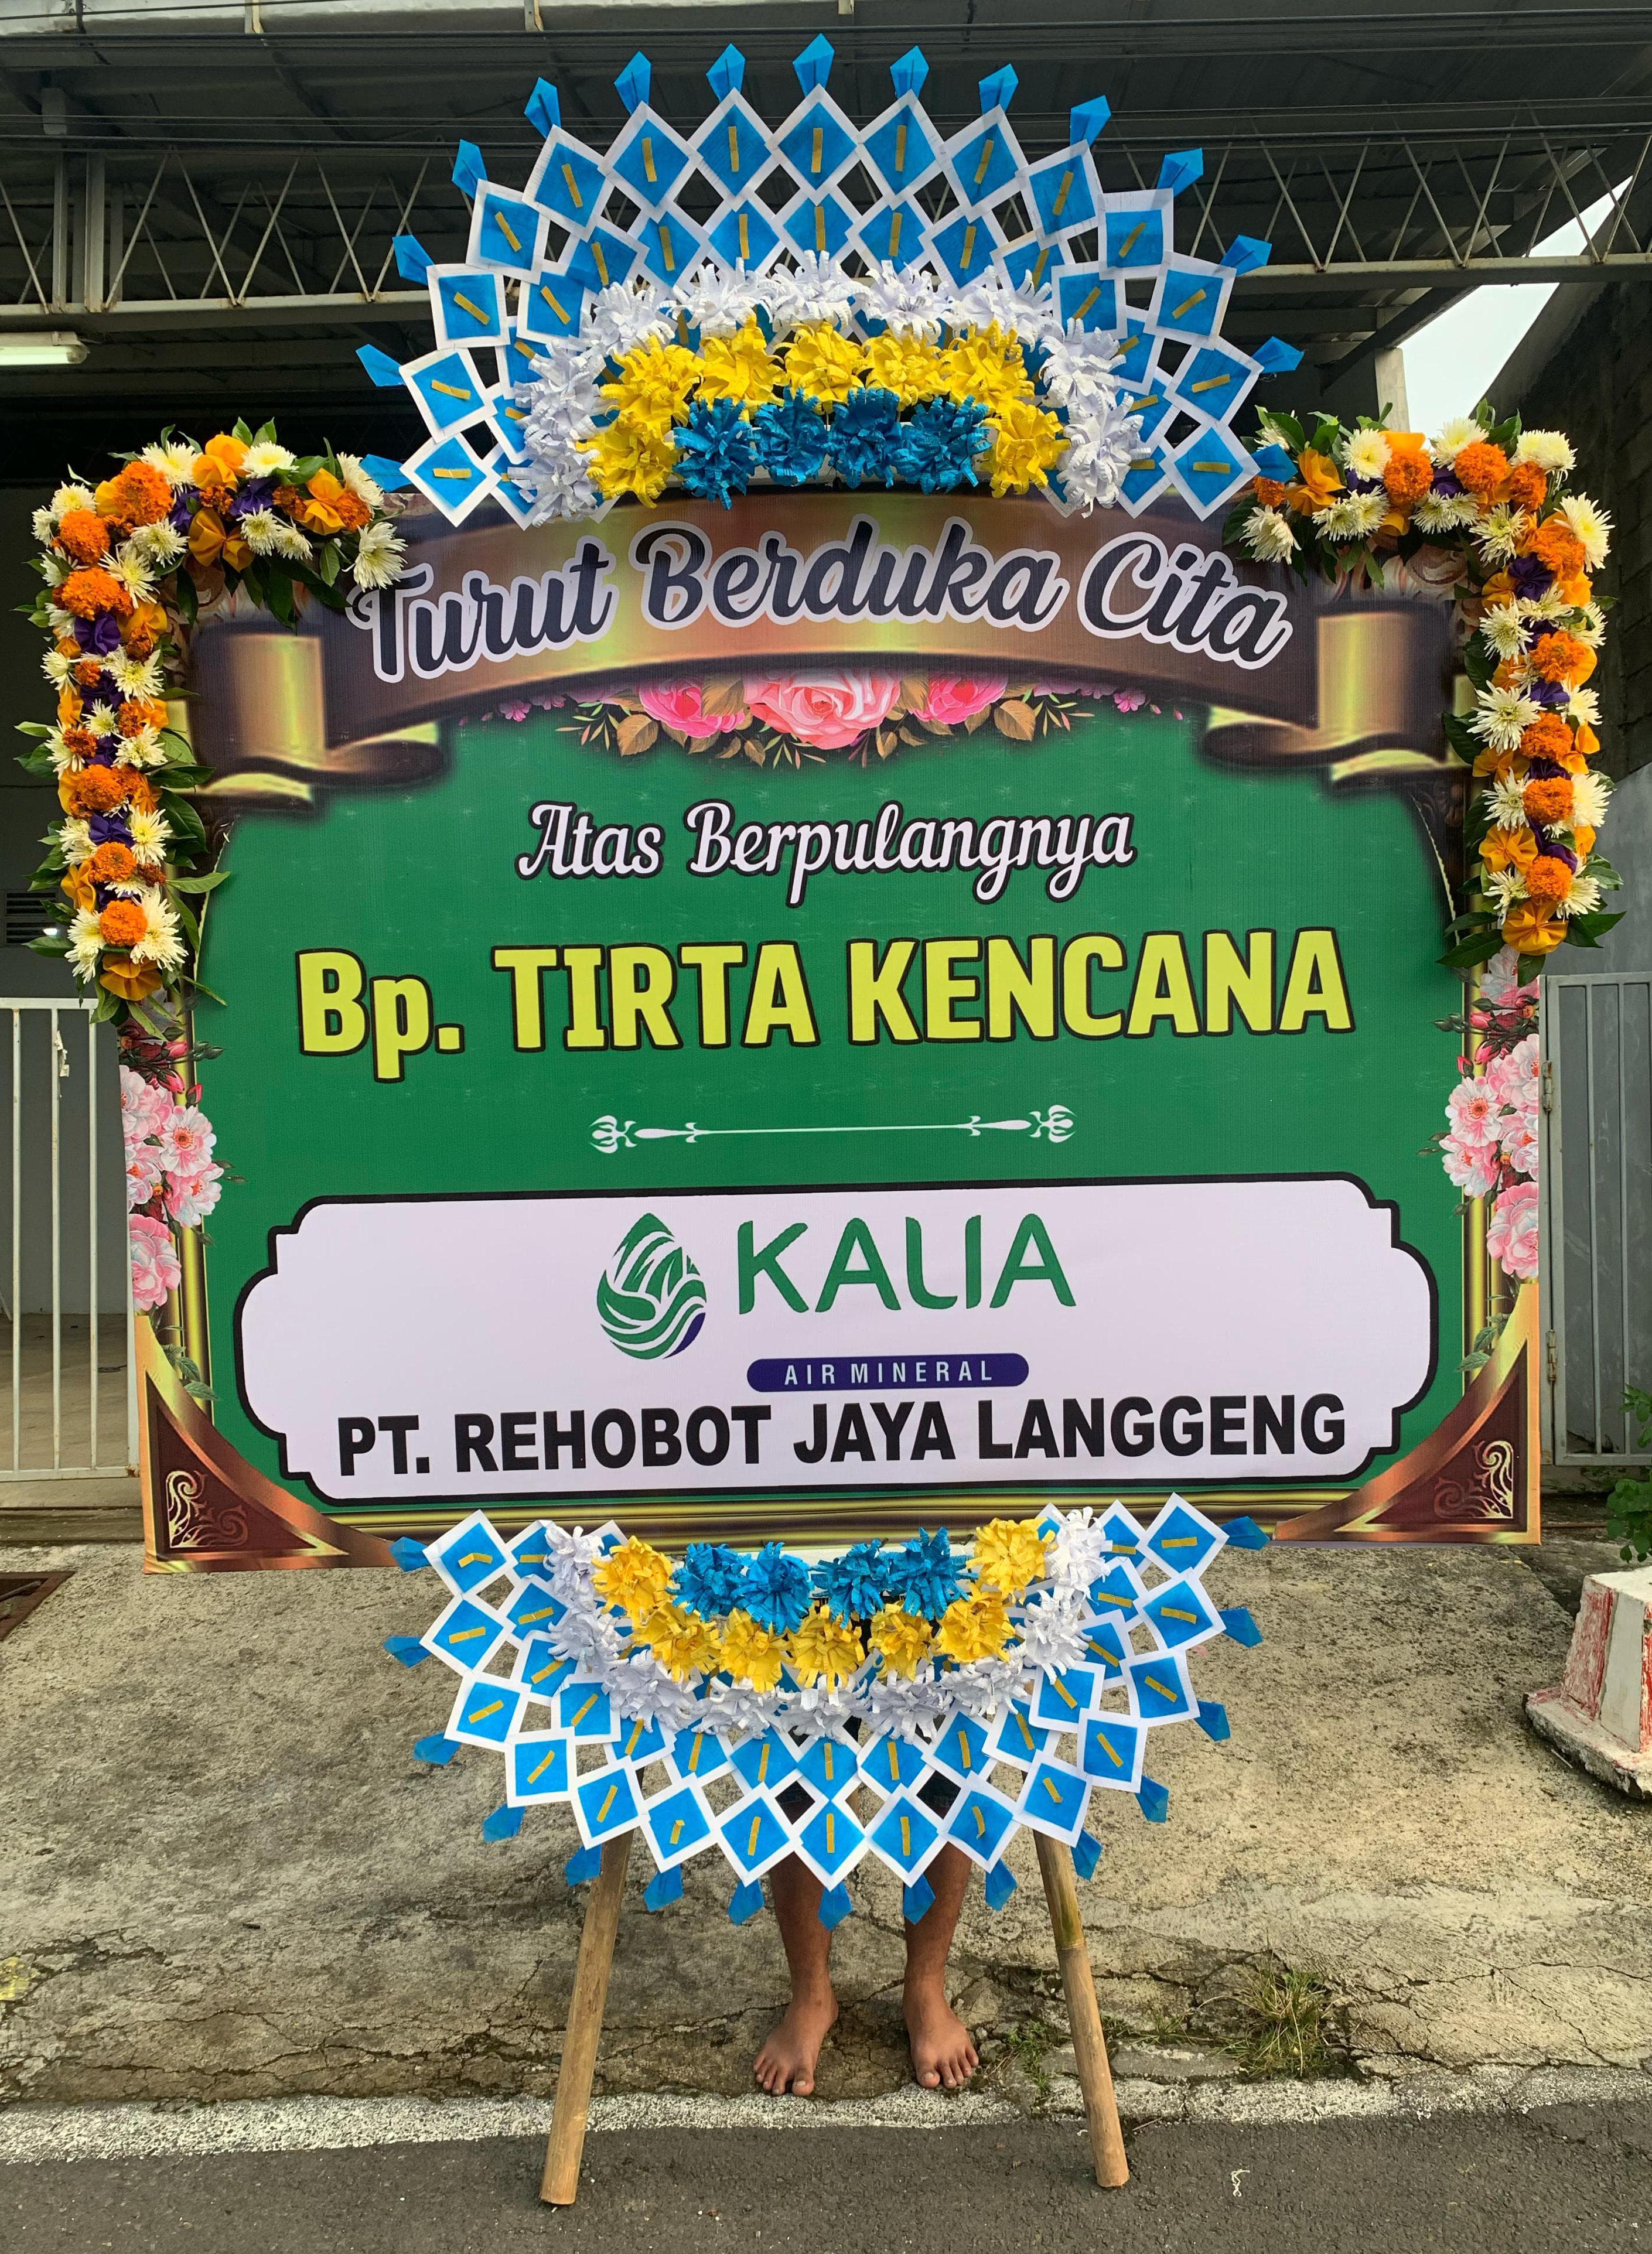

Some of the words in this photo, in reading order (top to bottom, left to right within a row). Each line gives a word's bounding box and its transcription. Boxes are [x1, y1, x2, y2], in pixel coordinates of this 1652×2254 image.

[346, 536, 619, 683] Turut
[629, 513, 1071, 632] Berduka
[1077, 531, 1293, 670] Cita
[514, 800, 665, 881] Atas
[682, 800, 1138, 909] Berpulangnya
[296, 947, 465, 1082] Bp.
[490, 941, 821, 1053] TIRTA
[846, 927, 1356, 1046] KENCANA
[737, 1213, 1077, 1315] KALIA
[784, 1364, 837, 1386] AIR
[850, 1360, 994, 1384] MINERAL
[337, 1415, 431, 1476] PT.
[455, 1404, 772, 1473] REHOBOT
[793, 1401, 956, 1462] JAYA
[977, 1393, 1346, 1460] LANGGENG
